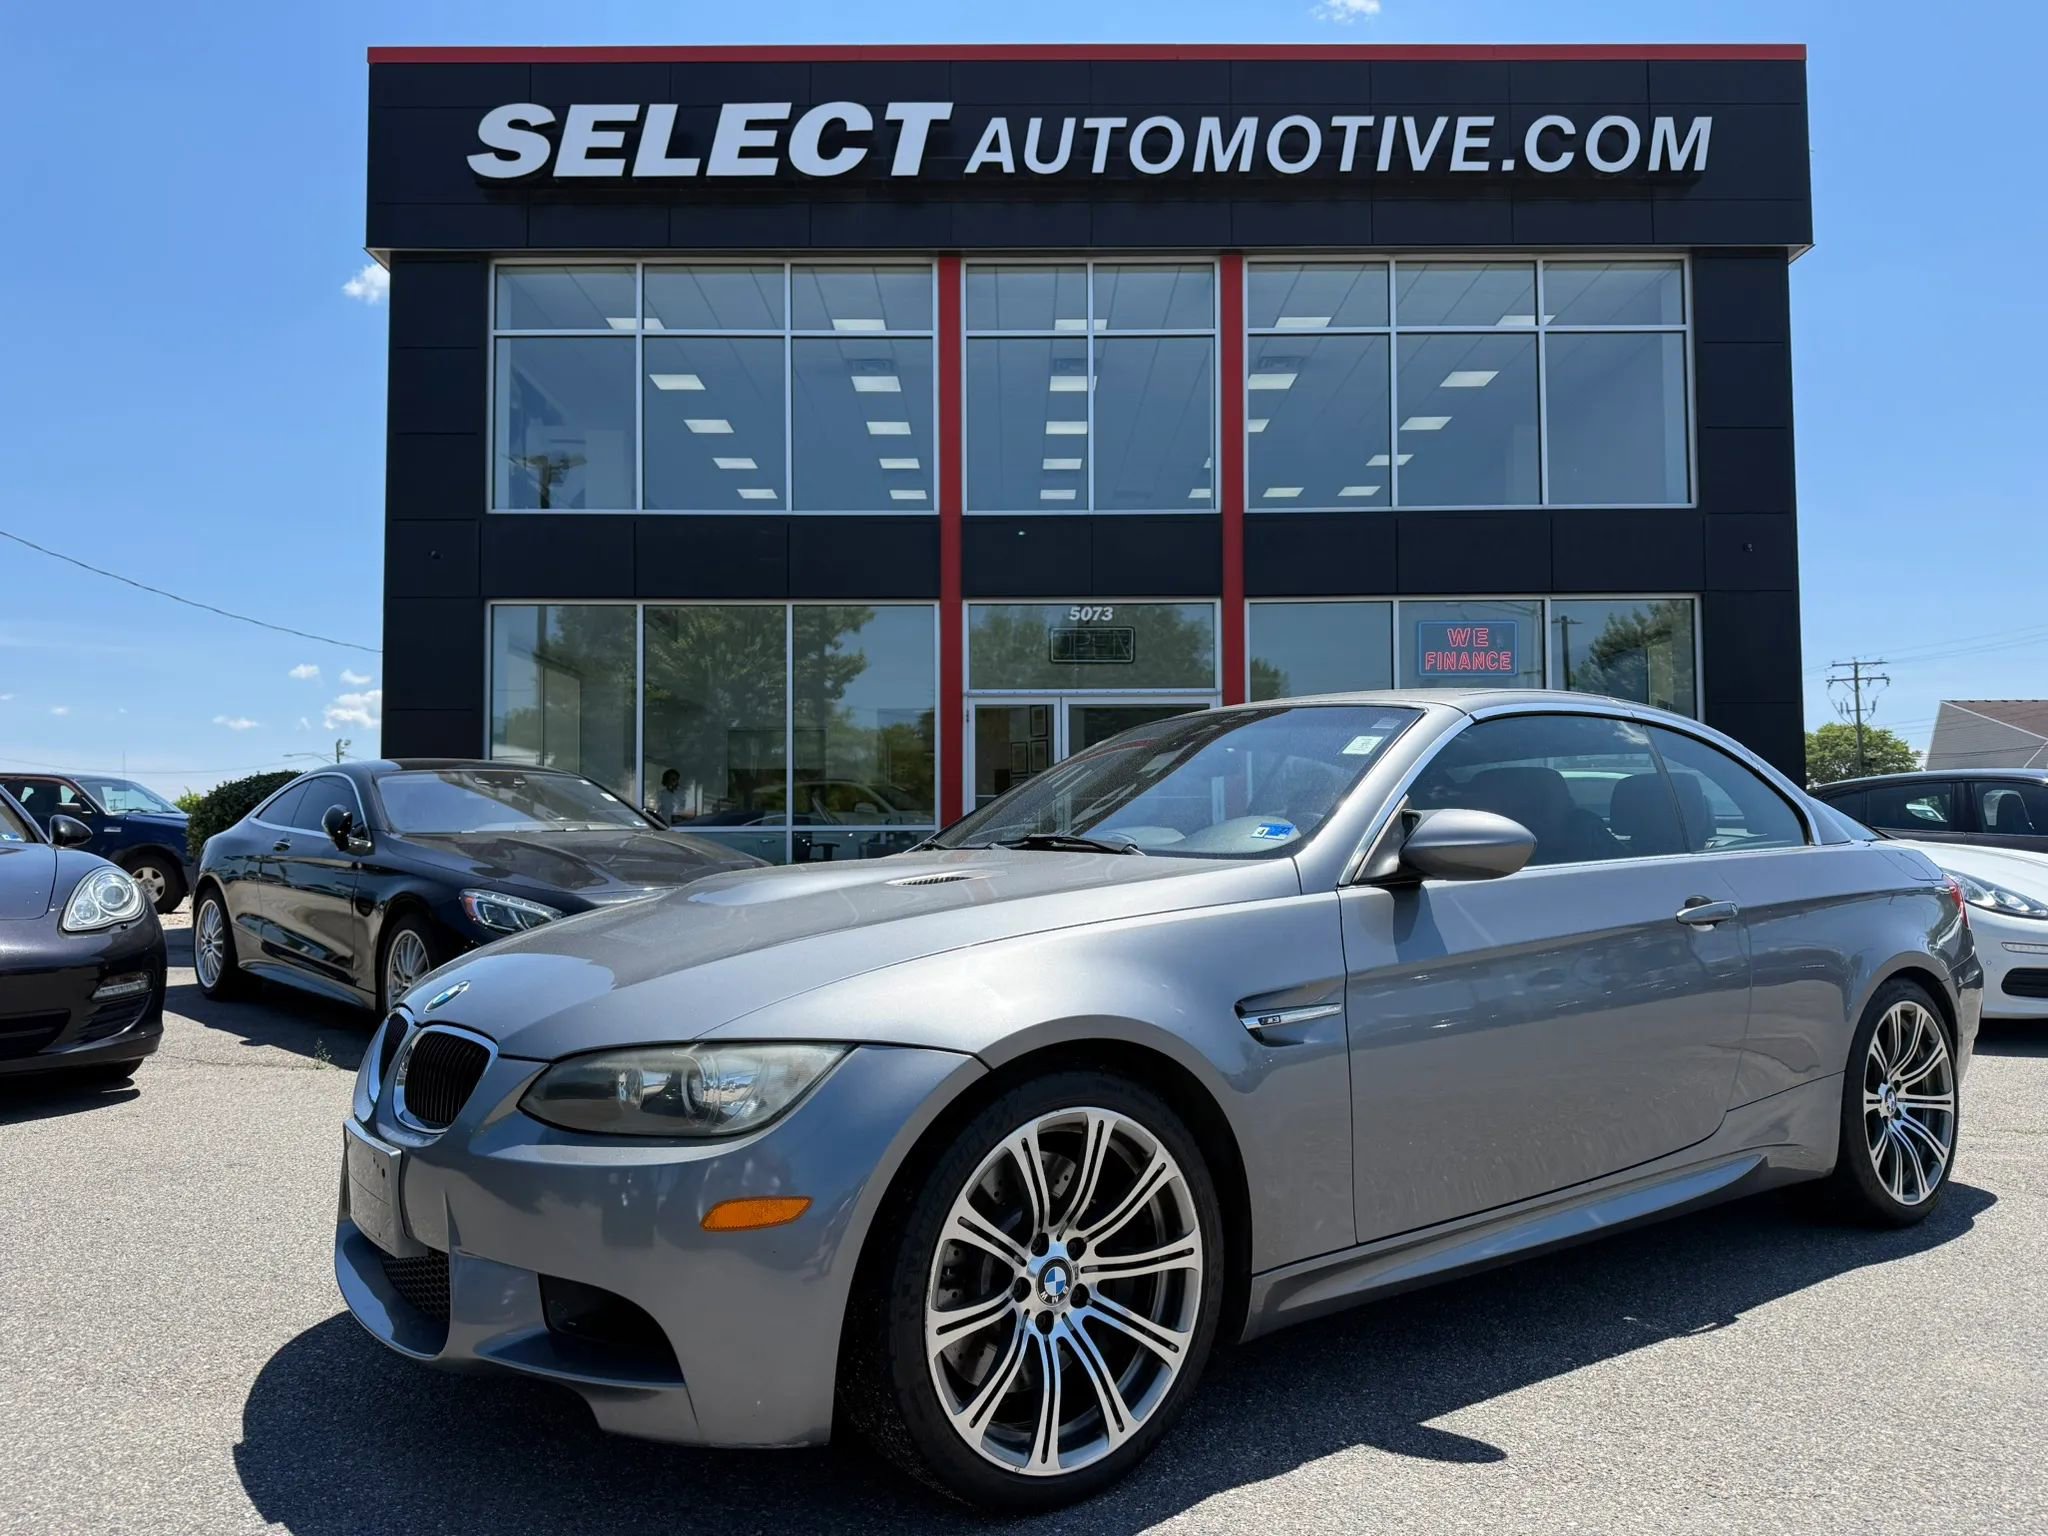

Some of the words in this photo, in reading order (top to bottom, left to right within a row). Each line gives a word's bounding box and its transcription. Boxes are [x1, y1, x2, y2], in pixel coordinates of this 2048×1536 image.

[466, 101, 954, 179] SELECT
[963, 114, 1713, 175] AUTOMOTIVE.COM
[1068, 606, 1113, 621] 5073
[1447, 628, 1489, 647] WE
[1425, 651, 1512, 671] FINANCE
